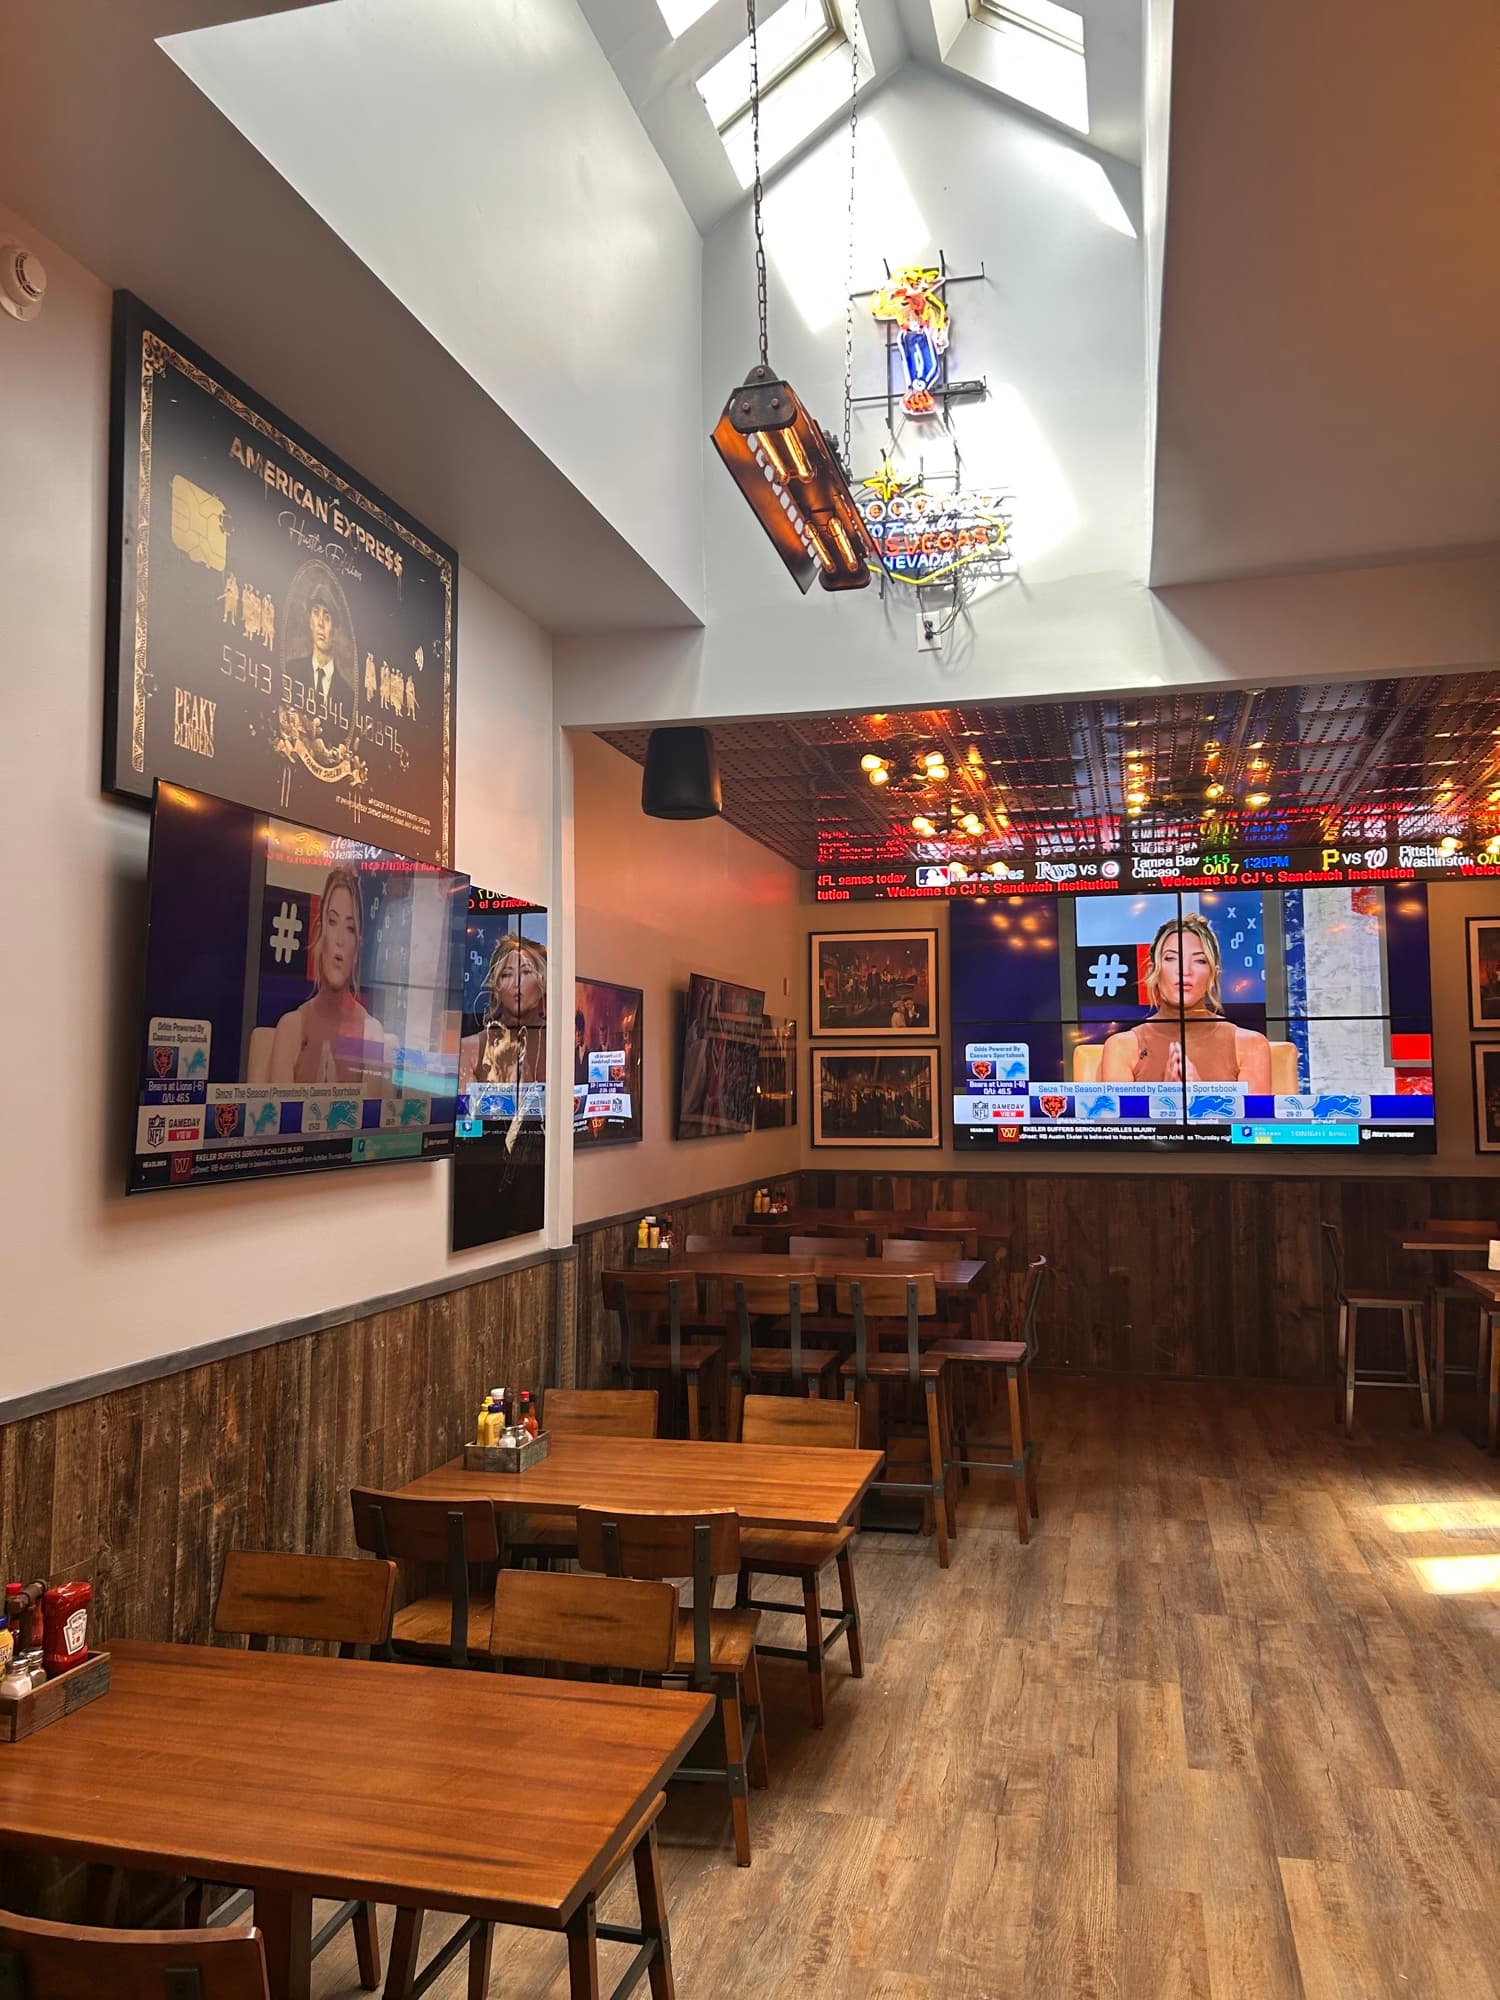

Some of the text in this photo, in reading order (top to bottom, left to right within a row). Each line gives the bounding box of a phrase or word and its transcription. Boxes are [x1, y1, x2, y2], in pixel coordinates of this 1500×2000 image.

[229, 436, 329, 524] AMERICAN
[220, 645, 272, 694] 5343
[281, 673, 348, 730] 338346
[174, 686, 217, 740] PEAKY
[1131, 853, 1289, 869] Tampa Bay +1.5 1:20PM
[1131, 864, 1239, 878] Chicago O/U 7
[838, 876, 874, 886] games
[876, 873, 907, 884] today
[887, 886, 941, 897] Welcome
[944, 885, 957, 896] to
[993, 881, 1052, 894] Sandwich
[1057, 879, 1118, 892] Institution
[1160, 876, 1220, 887] Welcome
[1224, 875, 1237, 885] to
[1278, 869, 1342, 881] Sandwich
[1348, 867, 1415, 880] Institution
[148, 1081, 167, 1091] Bears
[176, 1082, 192, 1090] Lions
[1038, 1084, 1237, 1094] Seize The Season Presented by Caesas Sportsbook
[234, 1088, 245, 1098] The
[247, 1088, 268, 1098] Season
[168, 1118, 200, 1128] GAMEDAY
[176, 1130, 191, 1139] VIEW
